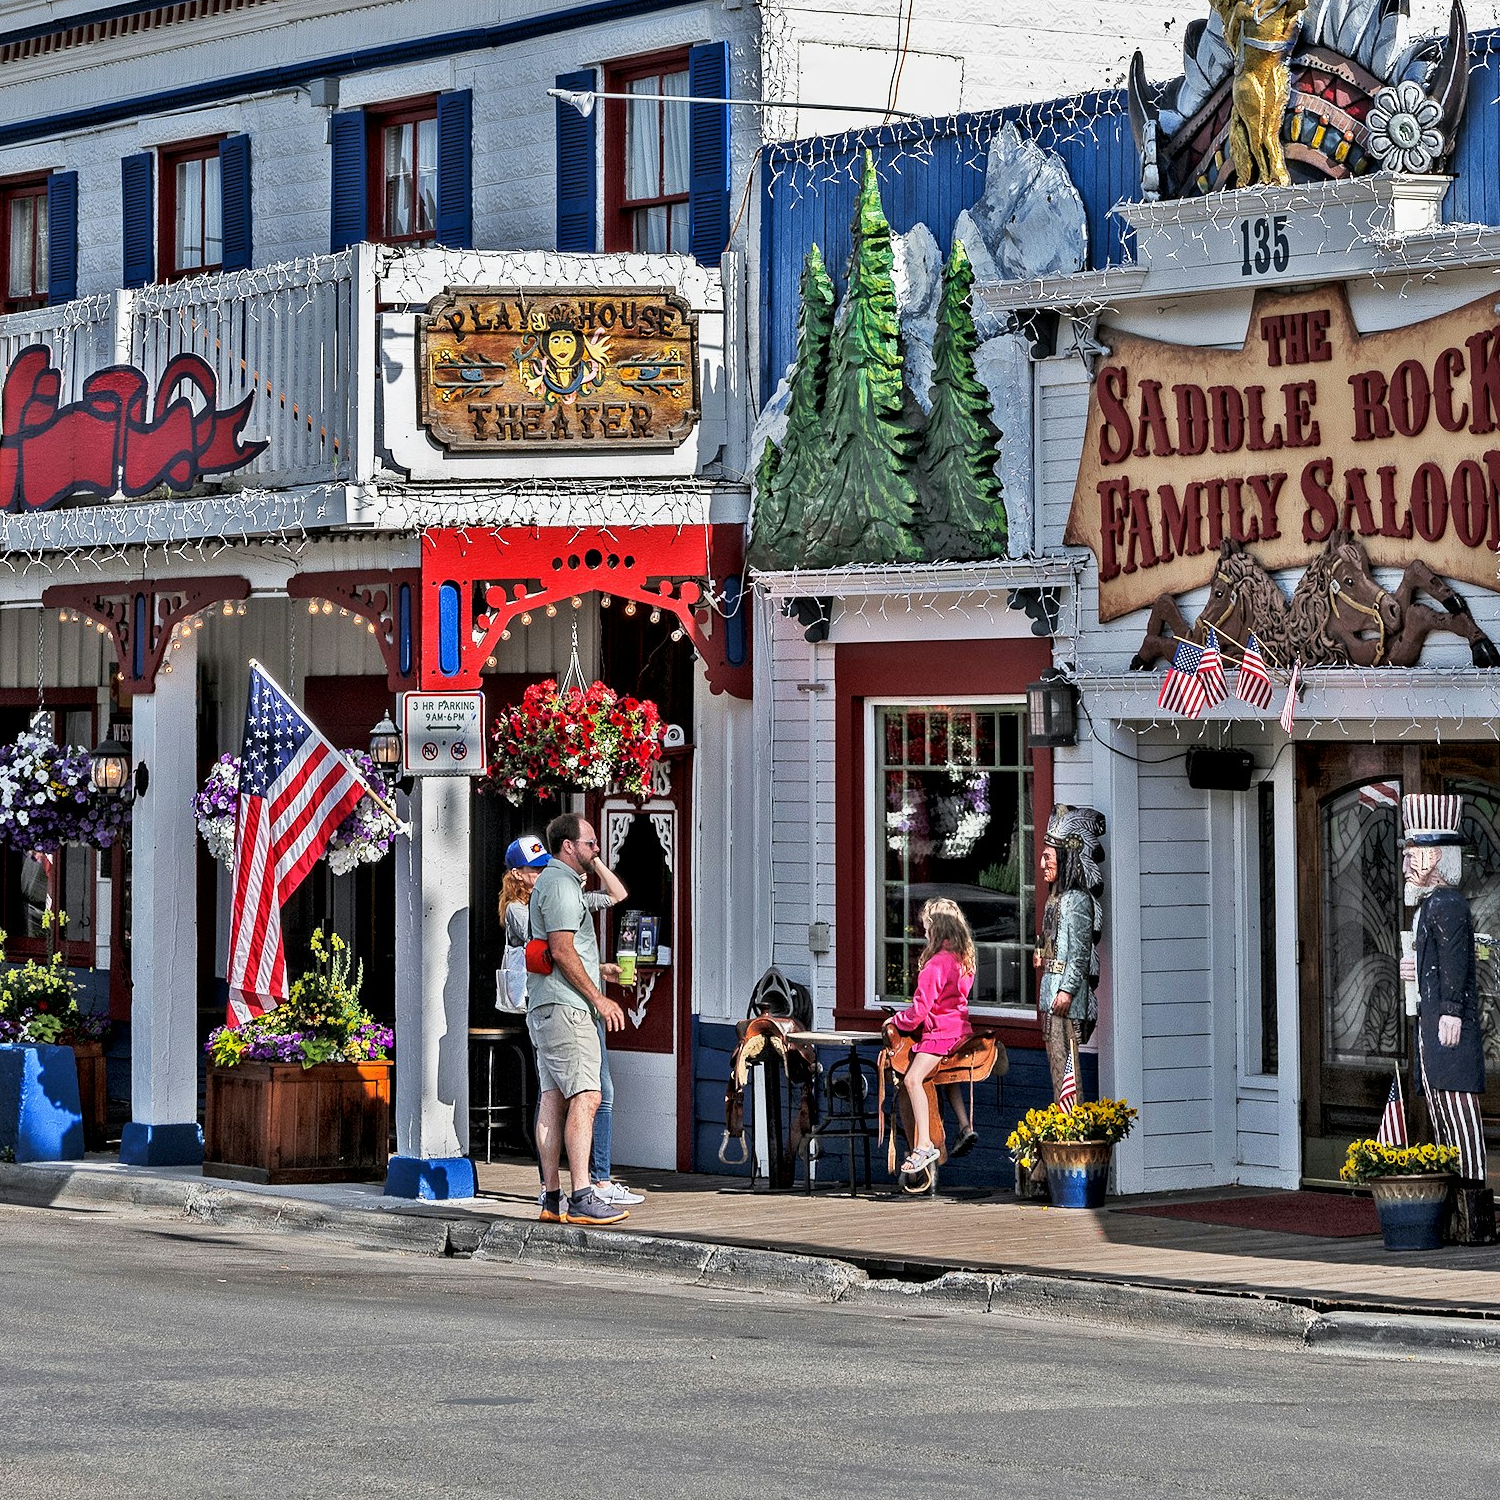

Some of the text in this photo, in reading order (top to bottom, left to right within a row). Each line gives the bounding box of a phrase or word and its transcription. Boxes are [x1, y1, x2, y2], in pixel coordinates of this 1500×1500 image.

[1240, 215, 1289, 276] 135
[444, 301, 676, 343] PLAY HOUSE
[1260, 308, 1333, 368] THE
[467, 401, 655, 441] THEATER
[1097, 365, 1321, 466] SADDLE
[1097, 472, 1288, 582] FAMILY
[412, 701, 475, 711] 3 HR PARKING
